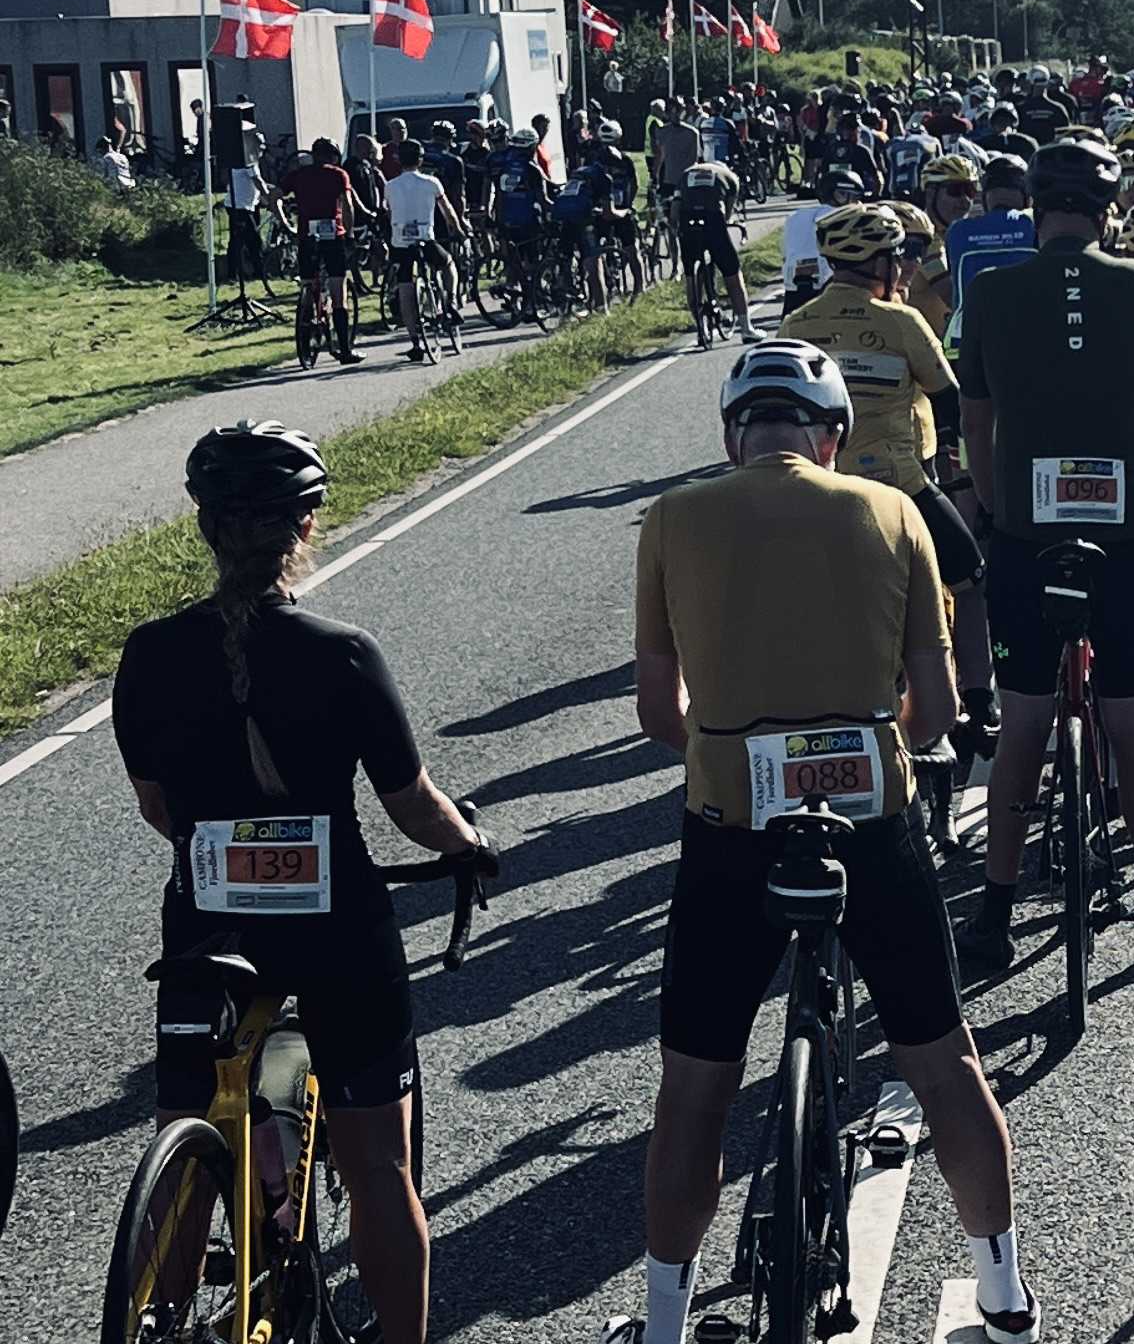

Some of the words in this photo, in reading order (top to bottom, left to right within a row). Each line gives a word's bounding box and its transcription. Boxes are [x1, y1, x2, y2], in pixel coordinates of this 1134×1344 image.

[1065, 267, 1083, 350] 2NED
[1066, 479, 1109, 500] 096
[811, 734, 862, 752] allbike
[798, 760, 859, 793] 088
[258, 822, 311, 838] allbike
[247, 849, 302, 879] 139
